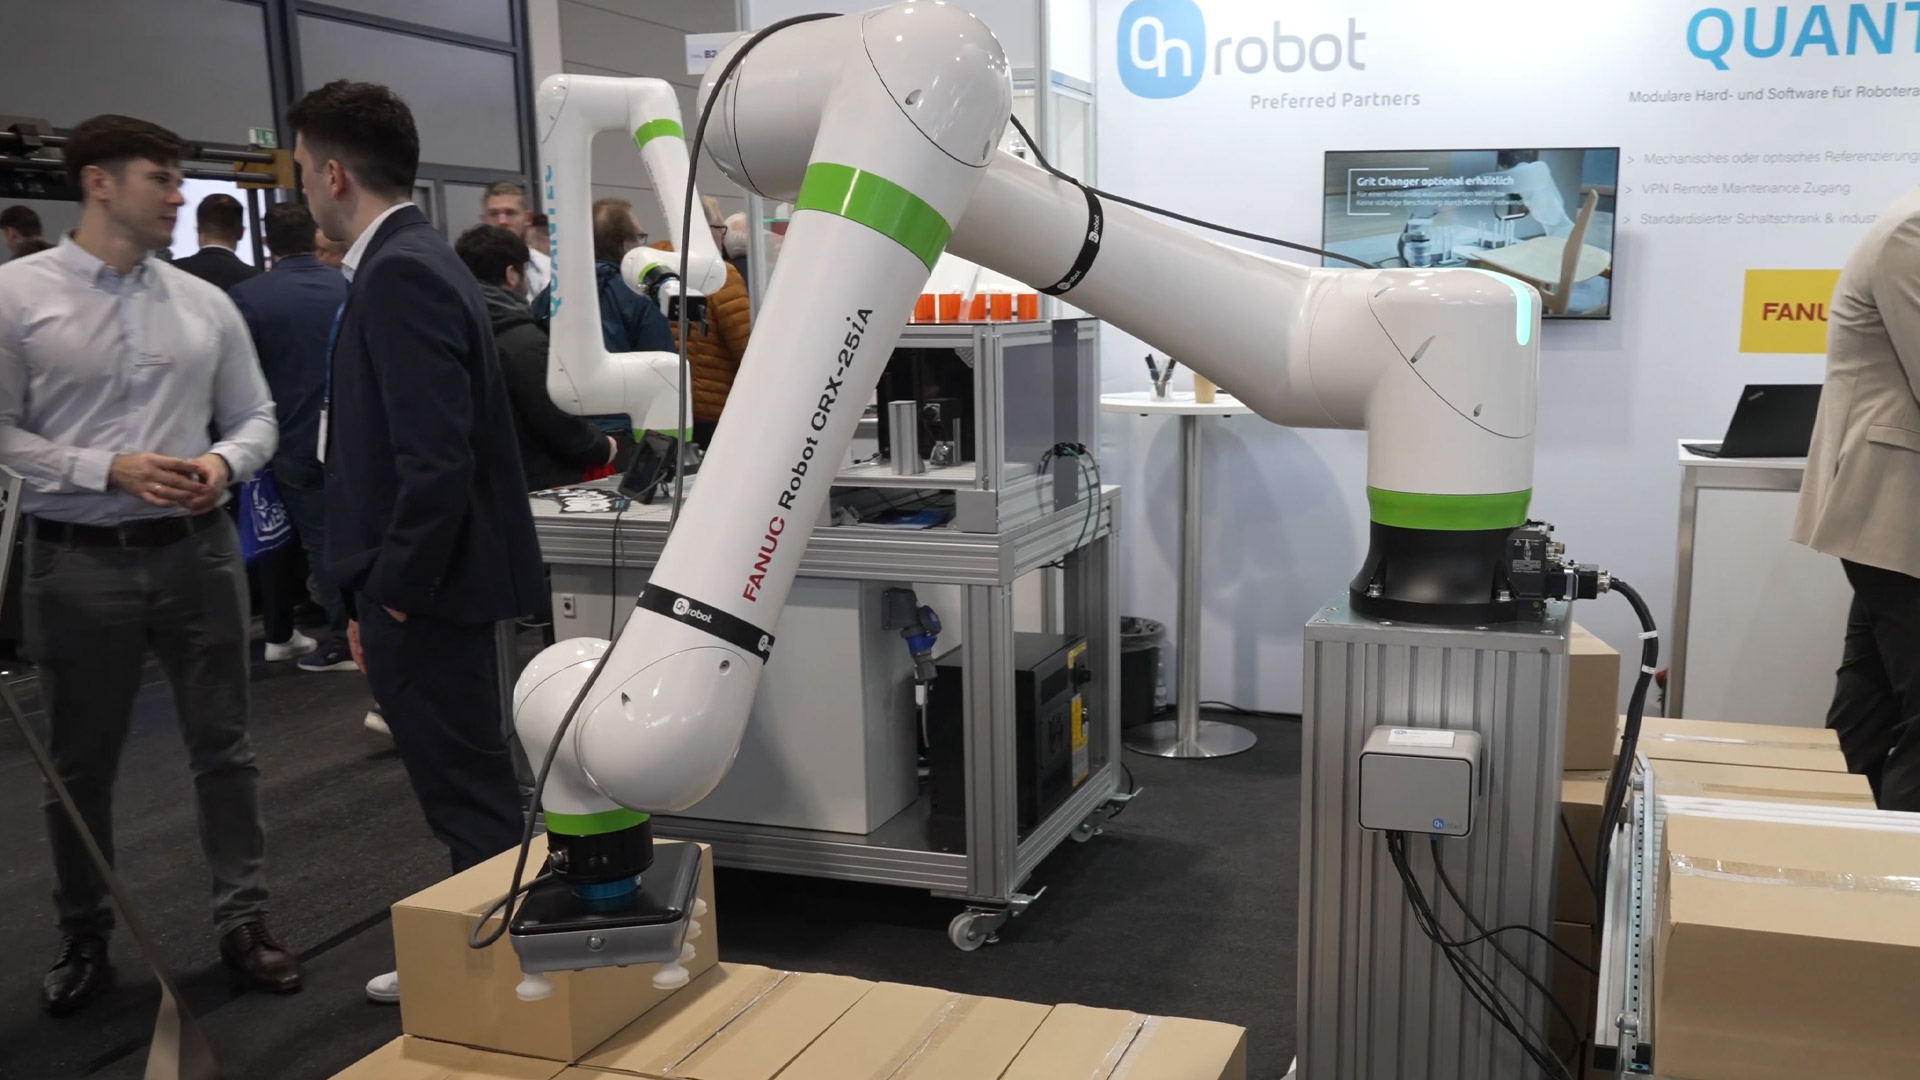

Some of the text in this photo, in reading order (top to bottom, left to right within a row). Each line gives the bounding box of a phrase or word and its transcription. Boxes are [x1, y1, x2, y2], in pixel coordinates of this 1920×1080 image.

[1250, 91, 1421, 110] Preferred Partners
[1629, 90, 1692, 103] Modulare
[1695, 89, 1734, 102] Hard-
[1737, 88, 1764, 101] und
[1767, 87, 1829, 101] Software
[1832, 86, 1852, 99] für
[1643, 152, 1729, 165] Mechanisches
[1732, 151, 1760, 164] oder
[1763, 151, 1821, 165] optisches
[1356, 175, 1515, 188] Grit Changer optional erhältlich
[1641, 181, 1851, 196] VPN Remote Maintenance Zugang
[1640, 212, 1879, 225] Standardisierter Schaltschrank & indust
[741, 307, 873, 603] FANUC Robot CRX-25iA
